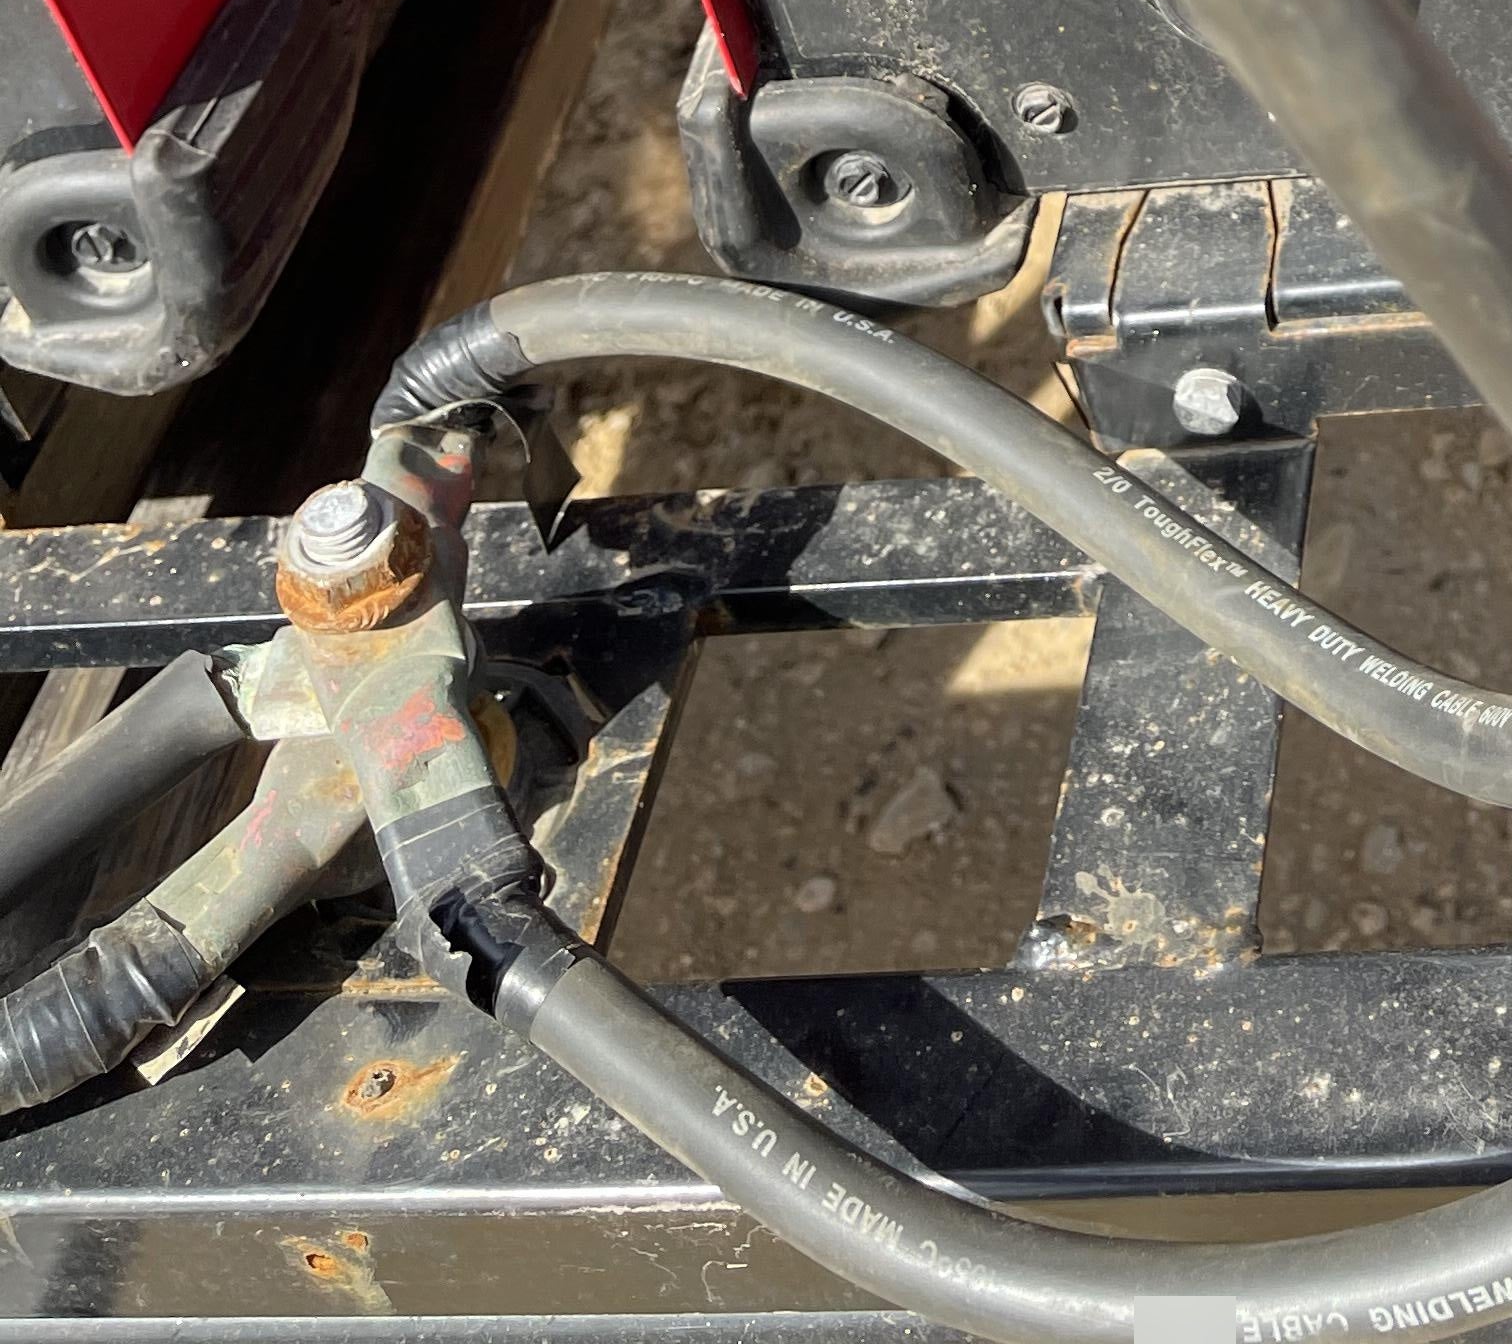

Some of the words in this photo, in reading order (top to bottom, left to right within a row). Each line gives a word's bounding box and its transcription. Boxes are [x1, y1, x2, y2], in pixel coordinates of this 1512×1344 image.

[832, 310, 896, 344] U.S.A.
[1092, 466, 1133, 494] 2/0
[1244, 580, 1315, 628] HEAVY
[1308, 624, 1366, 661] DUTY
[1358, 654, 1434, 701] WELDING
[1430, 689, 1483, 718] CABLE
[711, 1084, 778, 1158] U.S.A.
[781, 1151, 817, 1191] IN
[821, 1181, 904, 1250] MADE
